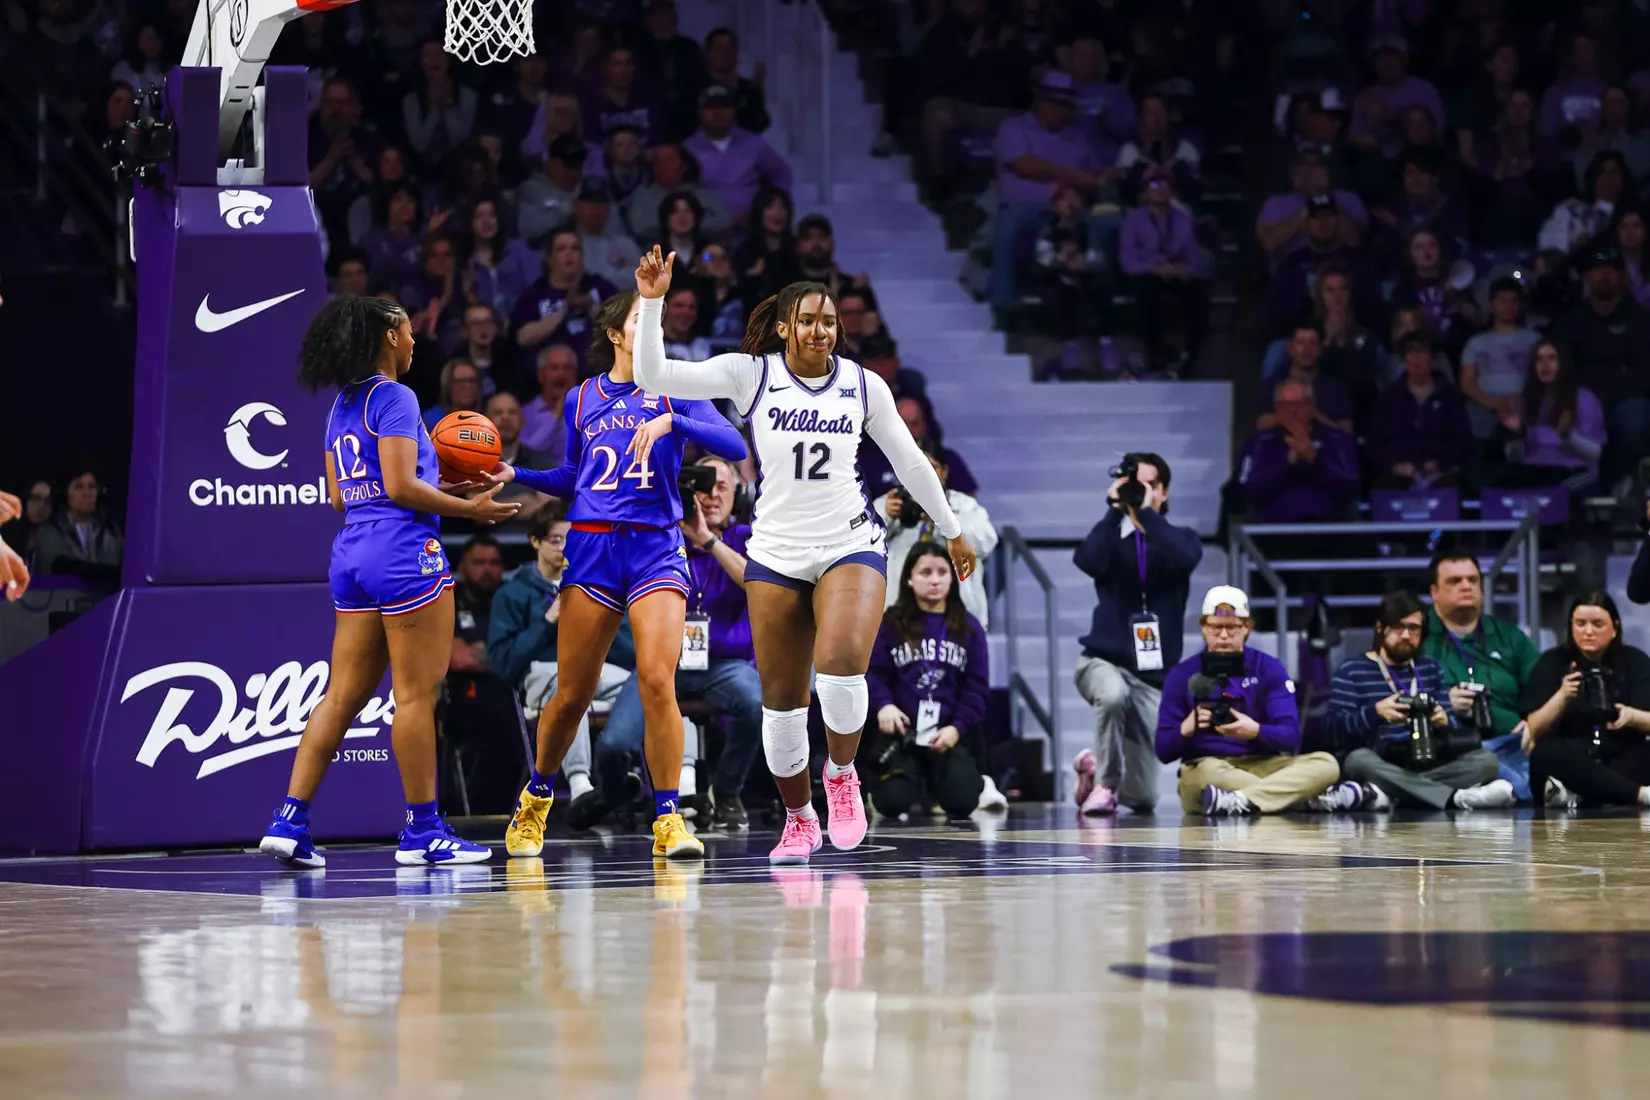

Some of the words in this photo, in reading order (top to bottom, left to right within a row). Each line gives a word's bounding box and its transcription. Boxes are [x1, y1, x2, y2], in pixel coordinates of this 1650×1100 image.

[838, 387, 857, 399] XII
[584, 414, 648, 440] KANSA
[768, 406, 854, 434] Wildcats
[458, 429, 496, 447] ELITE
[332, 434, 368, 482] 12
[590, 445, 655, 491] 24
[792, 441, 832, 480] 12
[340, 480, 381, 503] ICHOLS
[120, 660, 397, 768] Dills
[343, 748, 389, 762] STORES
